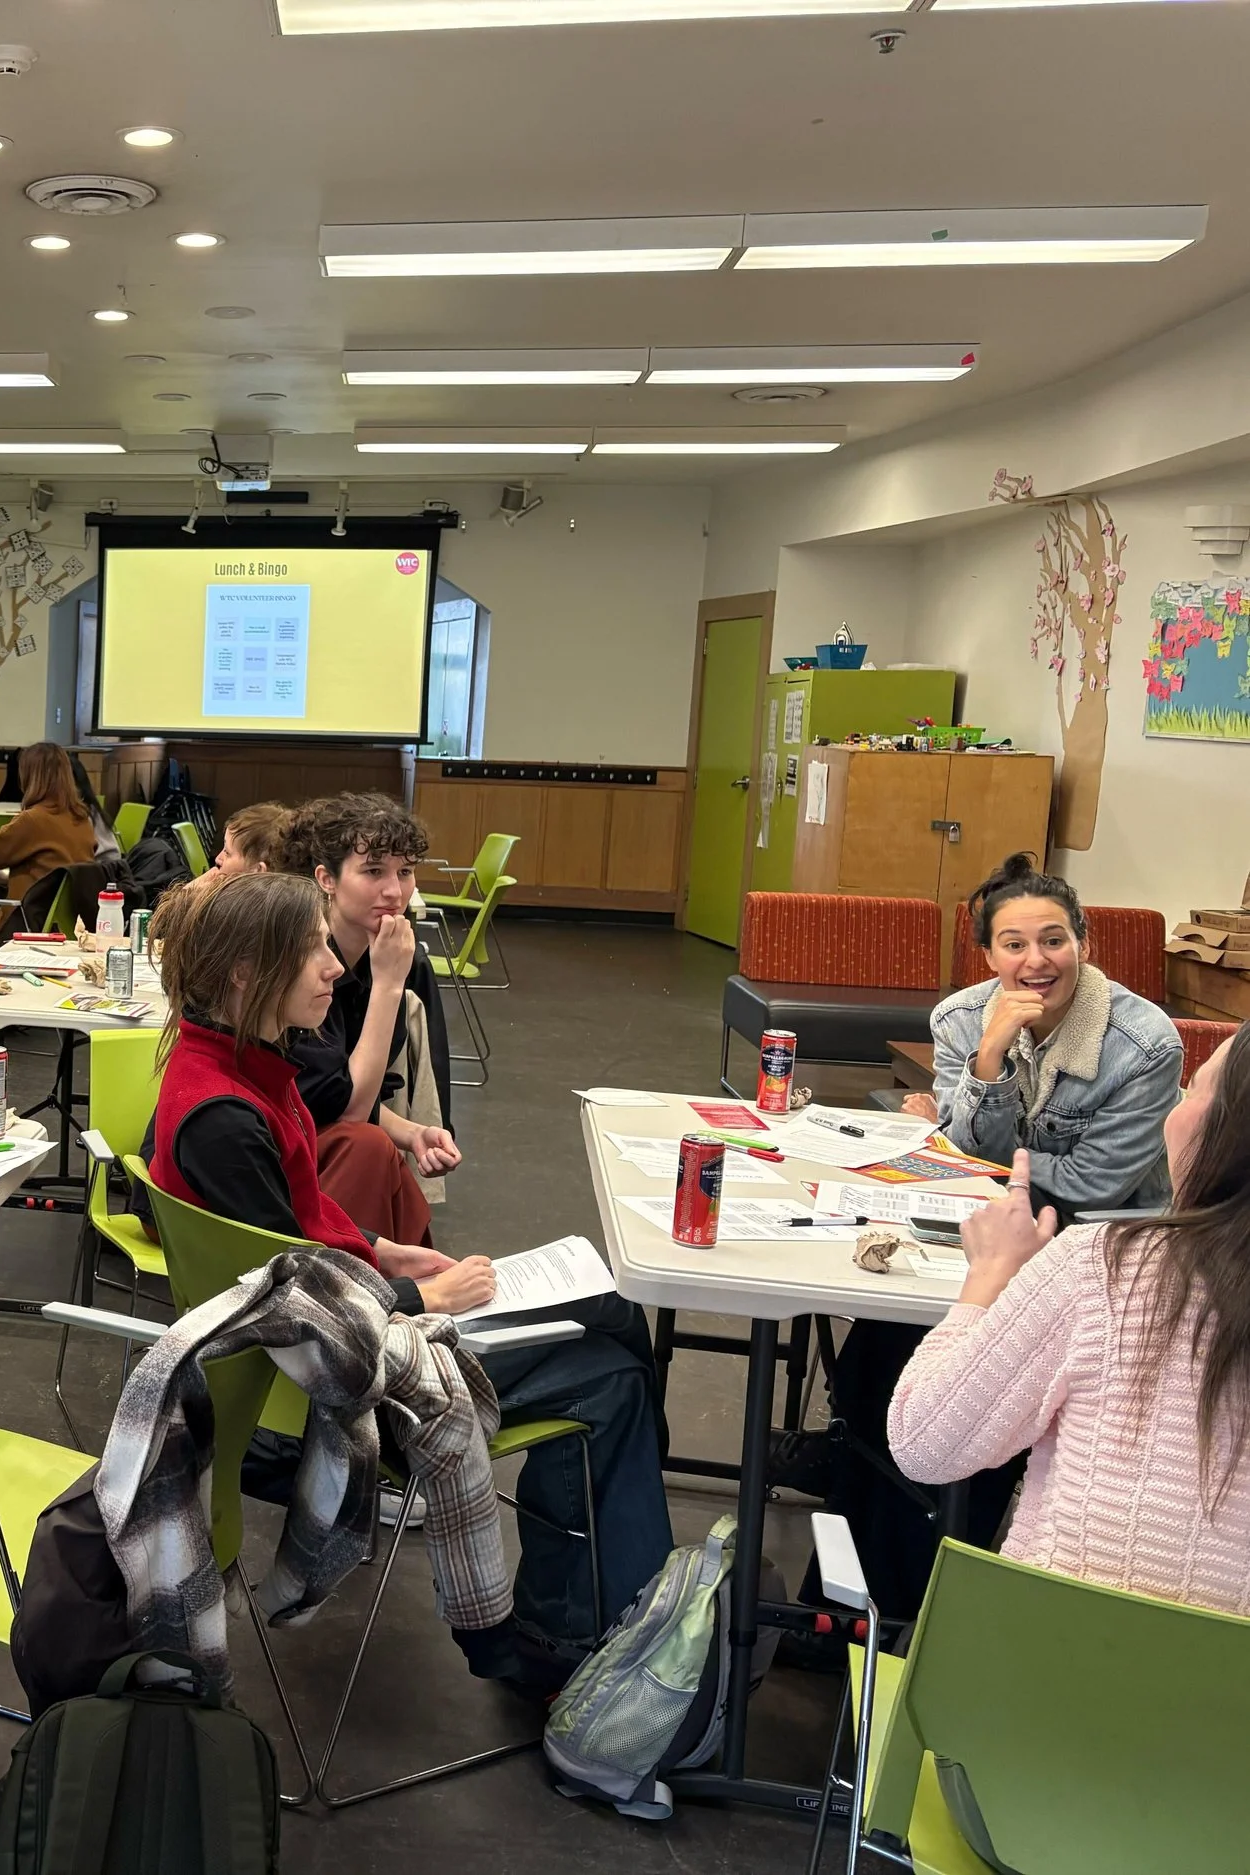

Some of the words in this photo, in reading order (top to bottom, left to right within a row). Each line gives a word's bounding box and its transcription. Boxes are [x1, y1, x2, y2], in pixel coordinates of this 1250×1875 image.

[215, 562, 245, 576] Lunch
[248, 563, 255, 576] &
[258, 562, 287, 577] Bingo
[98, 920, 111, 932] TC
[804, 1800, 850, 1813] LIFIME
